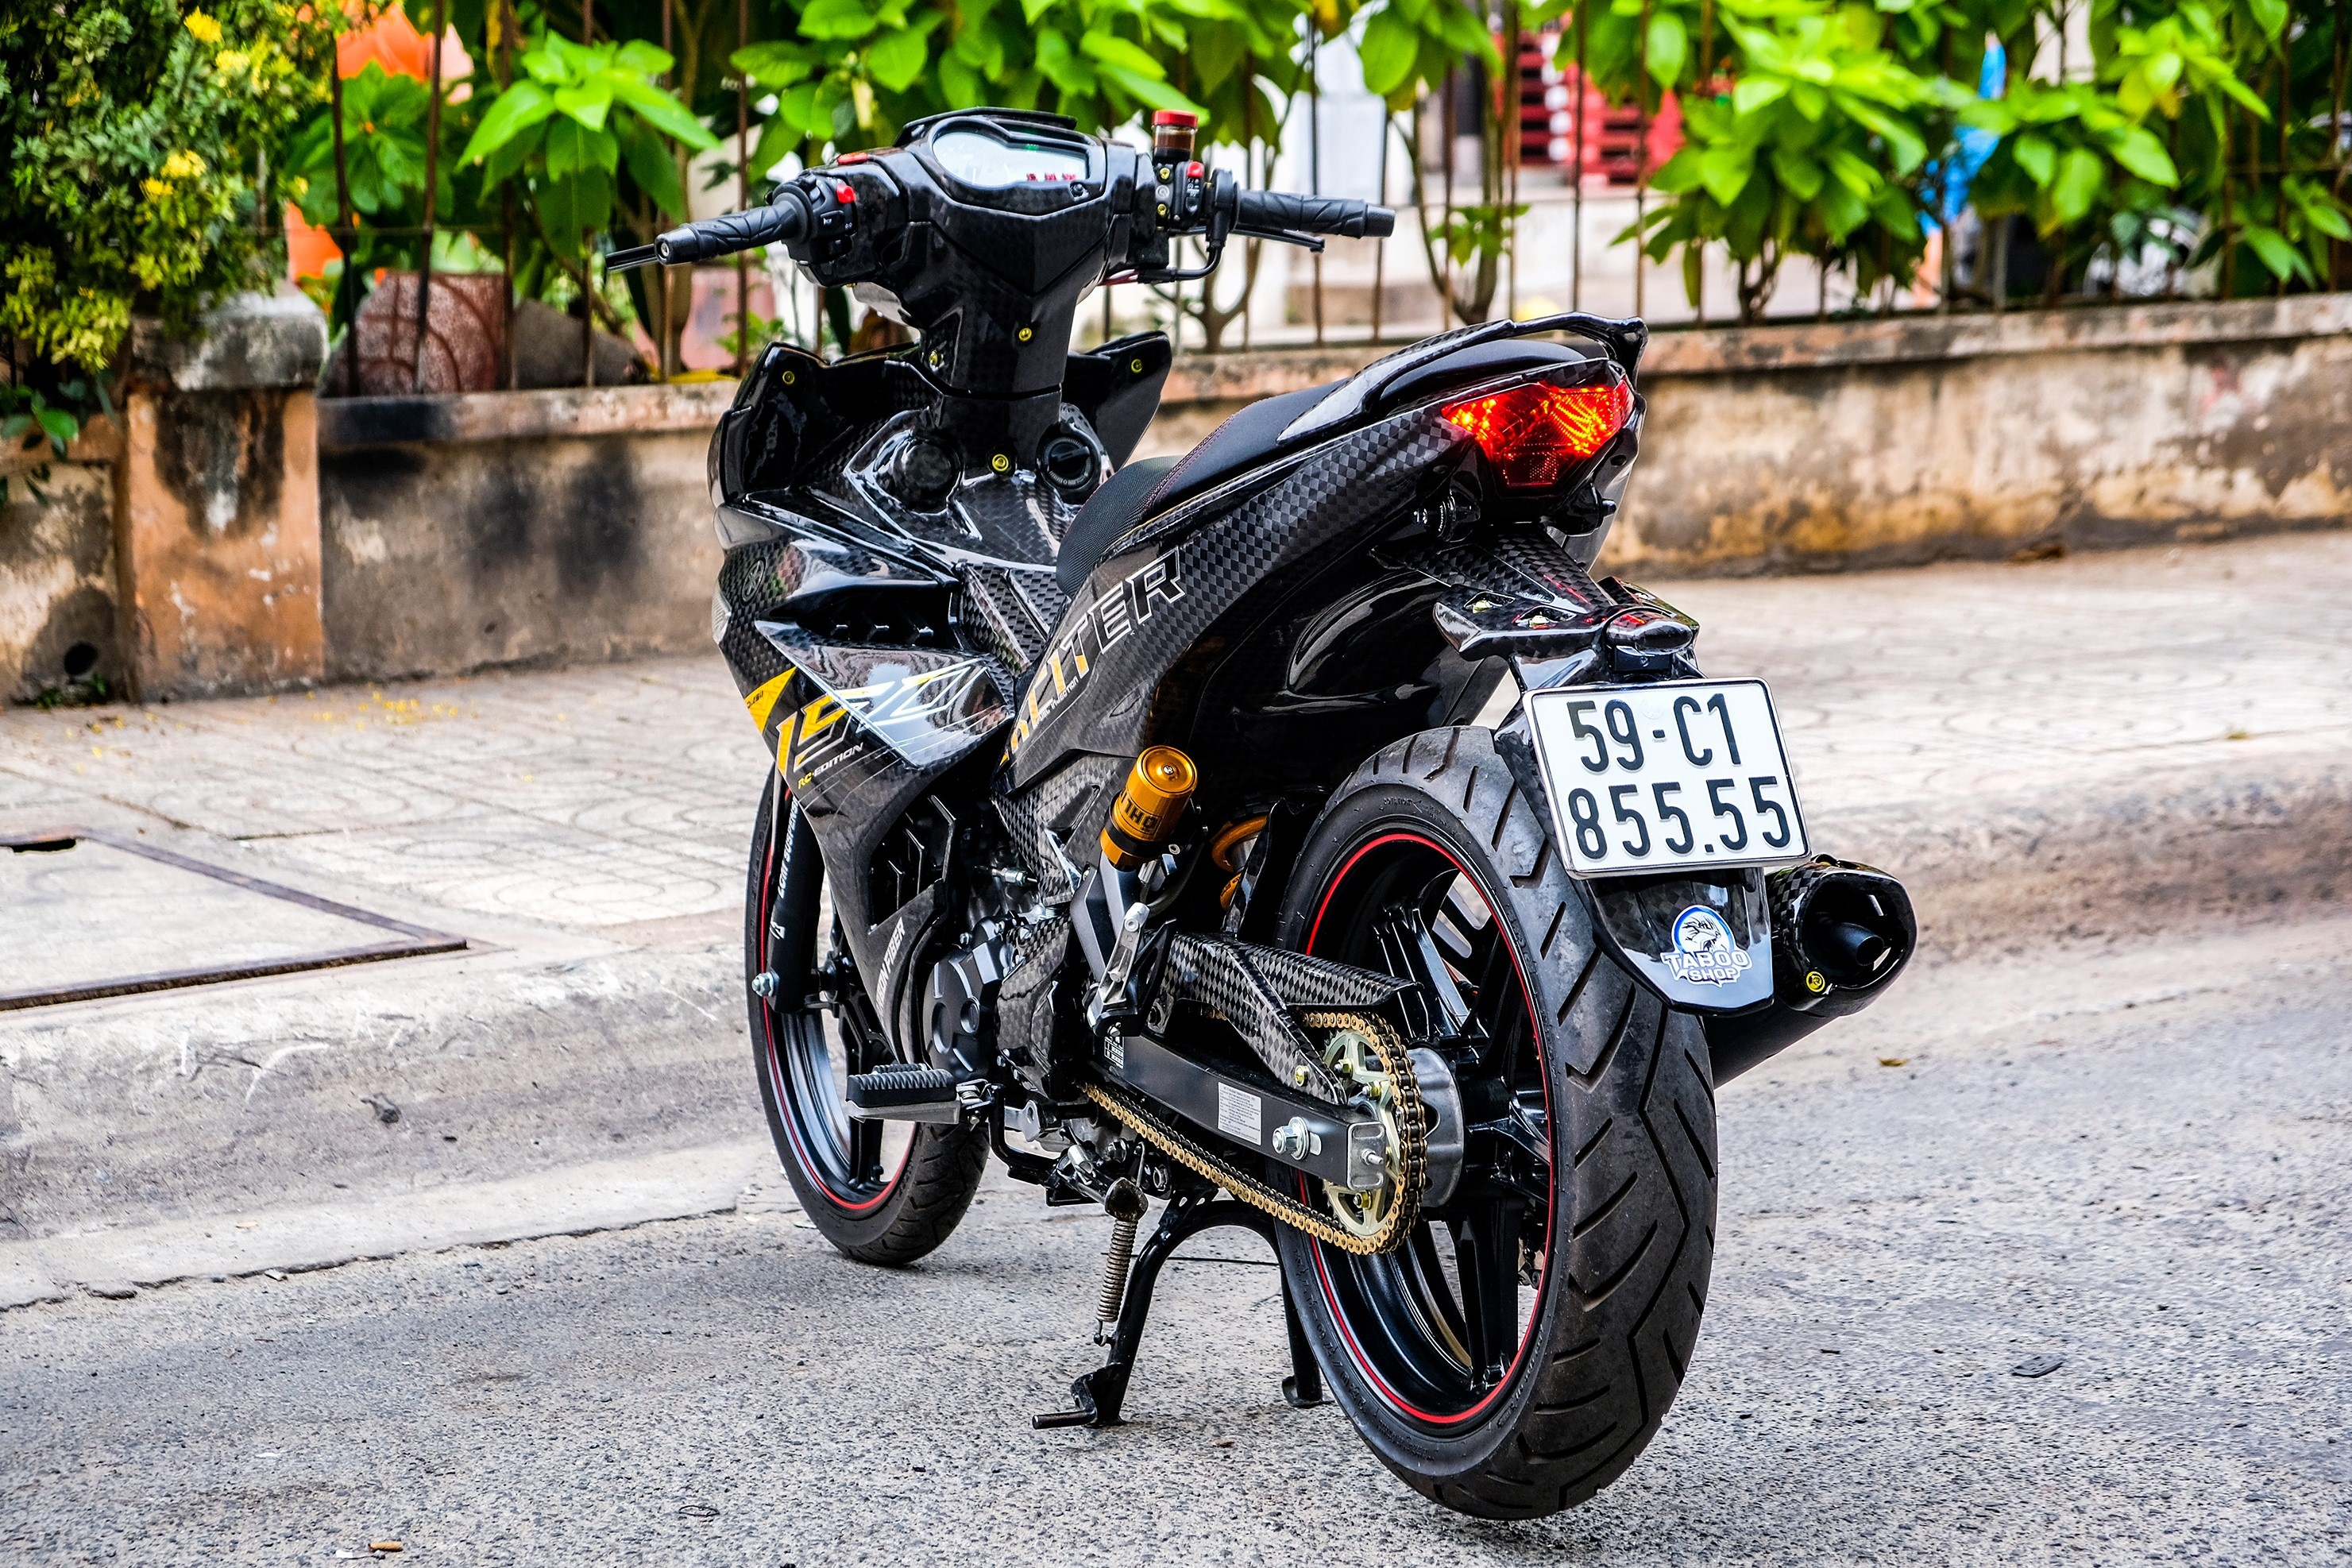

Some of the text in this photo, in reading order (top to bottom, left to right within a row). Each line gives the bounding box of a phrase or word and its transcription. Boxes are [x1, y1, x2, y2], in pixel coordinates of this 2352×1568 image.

[1566, 692, 1741, 773] 59-C1
[782, 794, 799, 864] SUSPENSI
[1567, 775, 1791, 860] 855.55
[883, 917, 906, 974] FIBER
[1663, 950, 1750, 971] TABOO
[1688, 967, 1737, 982] SHOP
